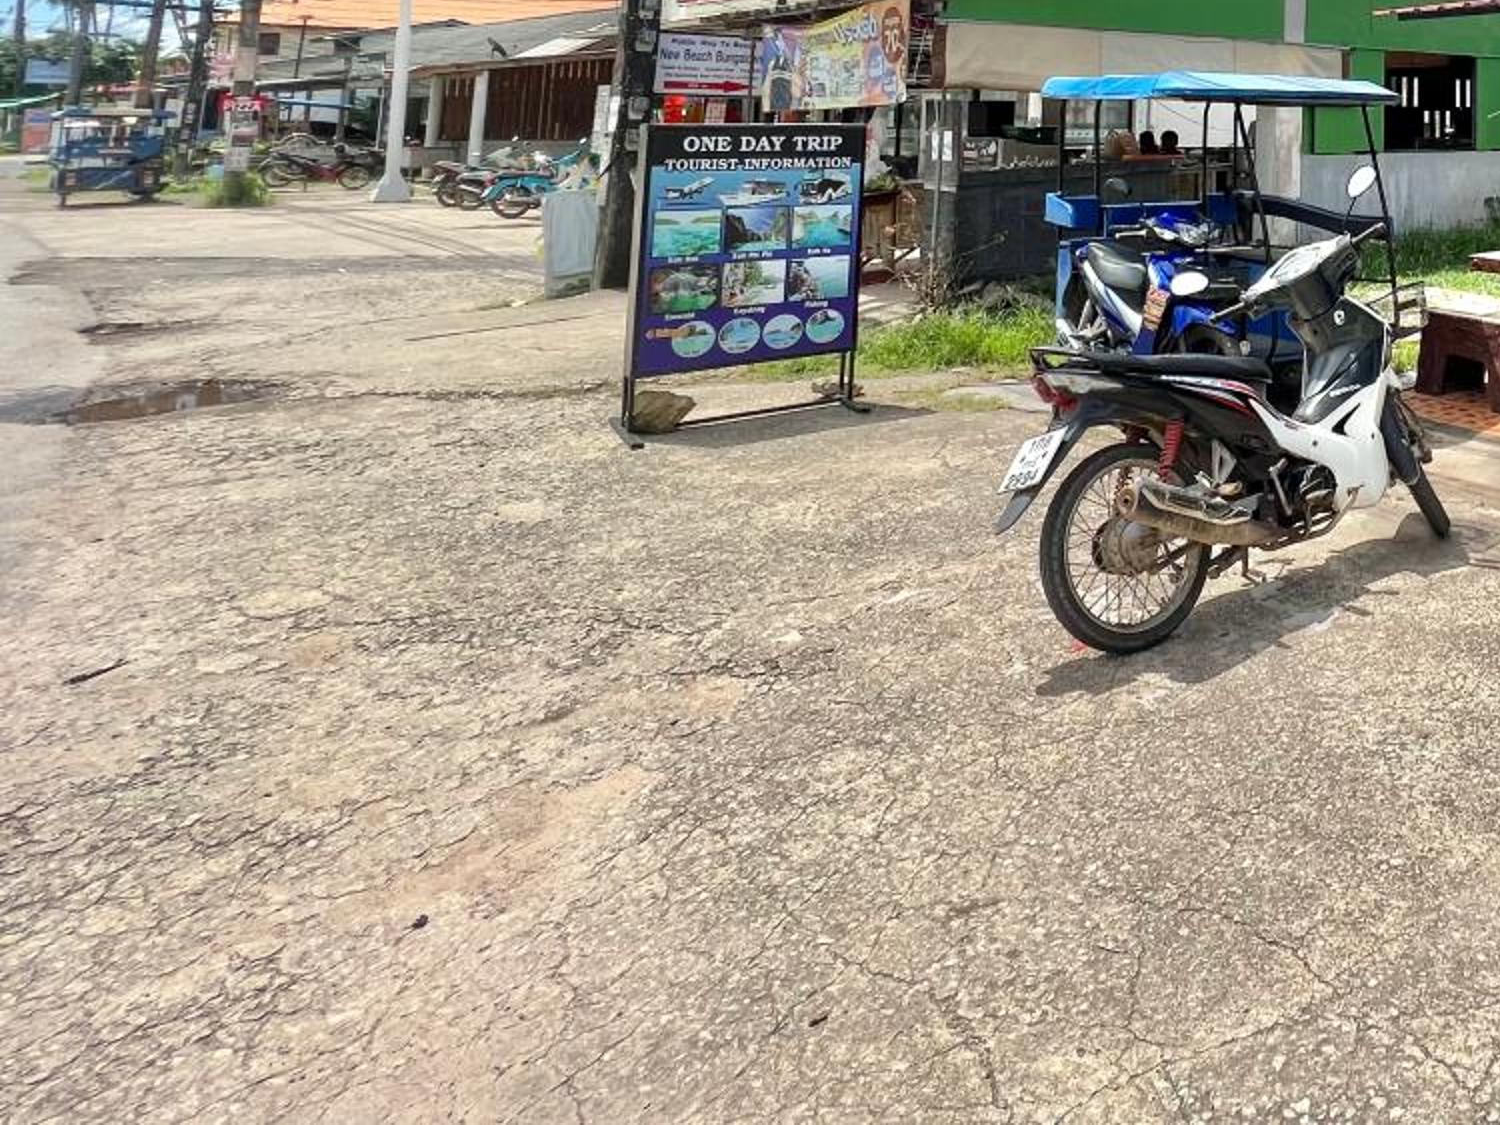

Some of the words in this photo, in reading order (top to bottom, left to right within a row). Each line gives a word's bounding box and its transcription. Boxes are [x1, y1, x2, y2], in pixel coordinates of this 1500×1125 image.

[683, 49, 713, 62] Beach
[683, 135, 732, 153] ONE
[739, 135, 786, 152] DAY
[793, 135, 843, 151] TRIP
[664, 158, 737, 172] TOURIST
[743, 156, 851, 171] INFORMATION
